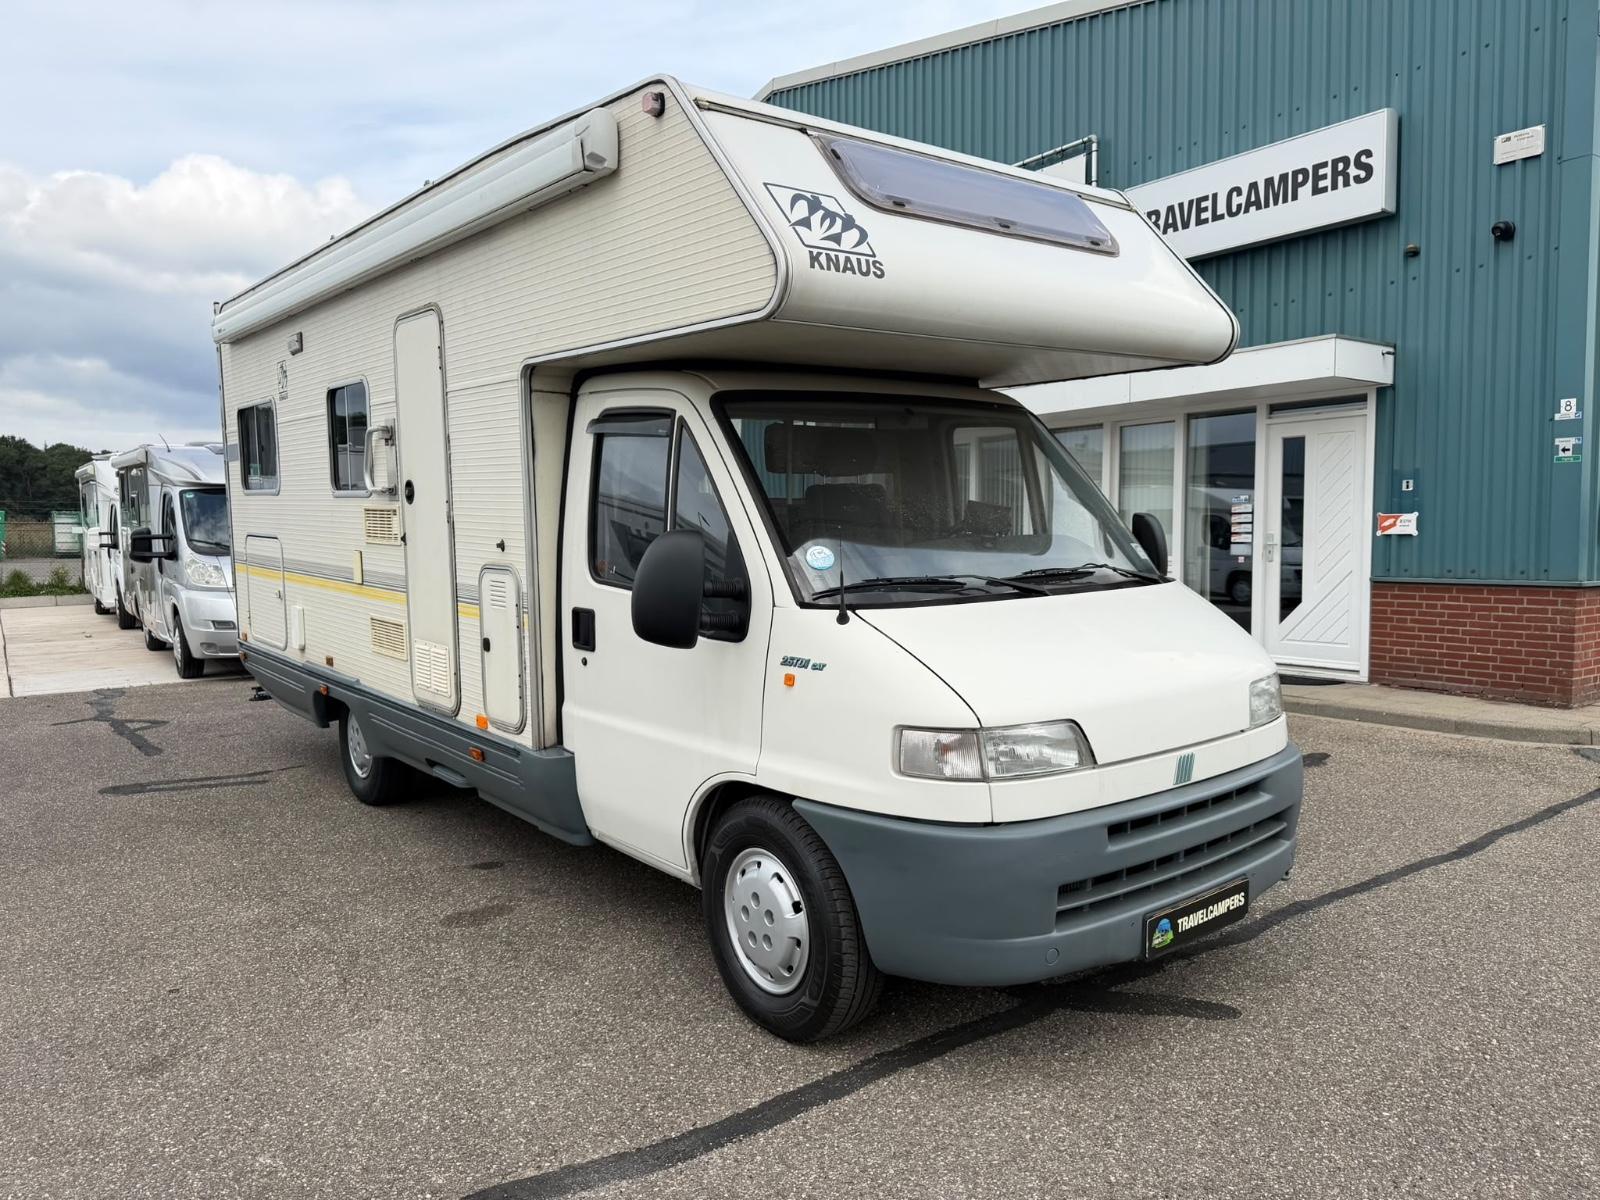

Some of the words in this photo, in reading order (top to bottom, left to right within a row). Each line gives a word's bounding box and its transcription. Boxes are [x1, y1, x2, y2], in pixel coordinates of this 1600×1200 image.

[1144, 148, 1374, 235] RAVELCAMPERS
[808, 250, 885, 279] KNAUS
[1564, 400, 1573, 412] 8
[1177, 892, 1246, 933] TRAVELCAMPERS
